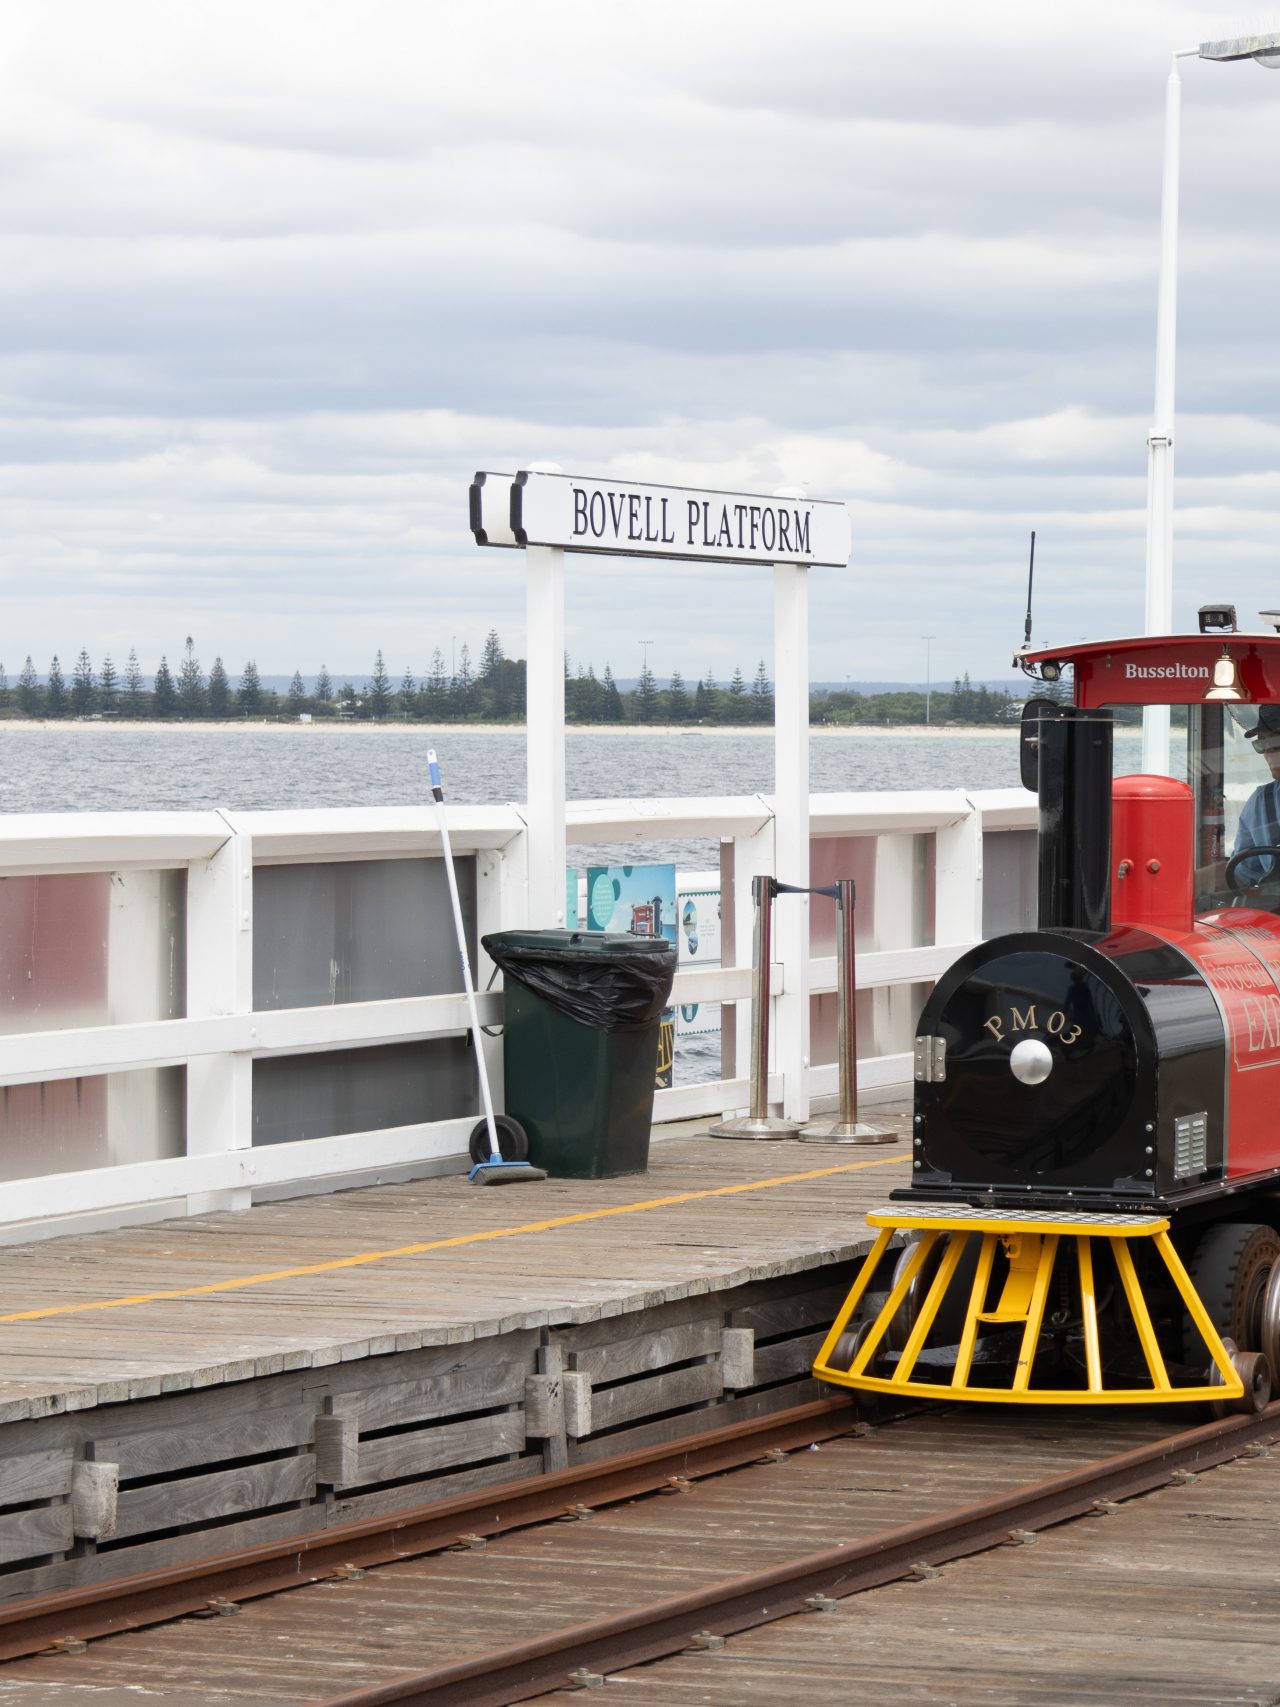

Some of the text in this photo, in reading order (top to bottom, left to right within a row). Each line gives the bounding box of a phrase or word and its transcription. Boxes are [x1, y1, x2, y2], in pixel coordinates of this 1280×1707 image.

[573, 488, 812, 554] BOVELL PLATFORM
[1125, 663, 1209, 679] Busselton
